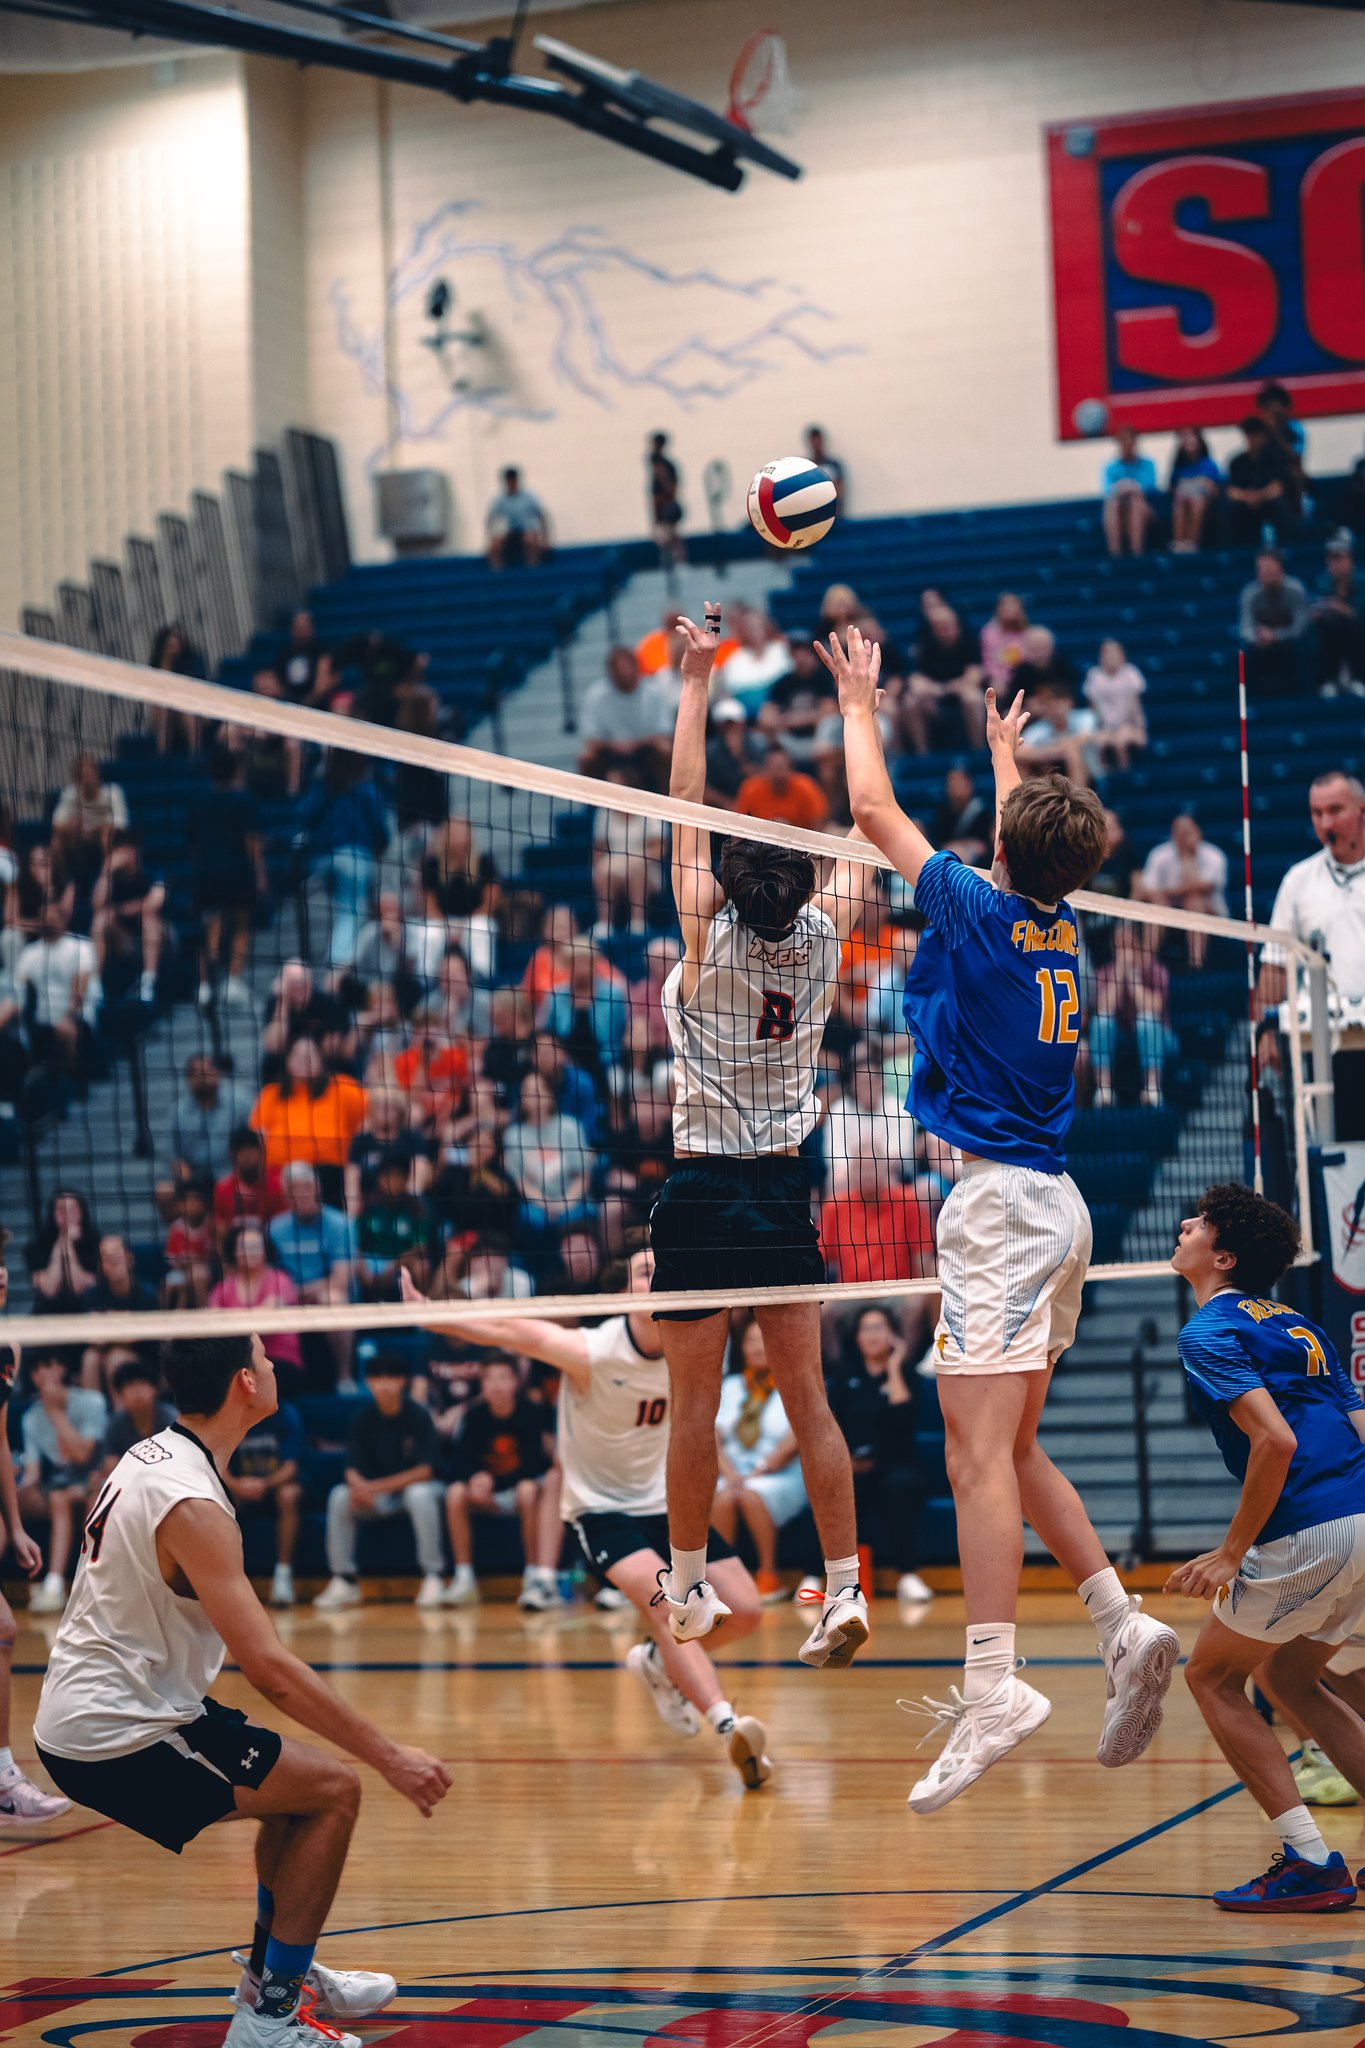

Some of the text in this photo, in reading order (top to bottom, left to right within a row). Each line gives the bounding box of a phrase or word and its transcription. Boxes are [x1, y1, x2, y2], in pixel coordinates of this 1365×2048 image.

[756, 989, 795, 1041] 8
[1035, 967, 1079, 1044] 12
[1286, 1325, 1331, 1377] 7
[635, 1397, 667, 1427] 10
